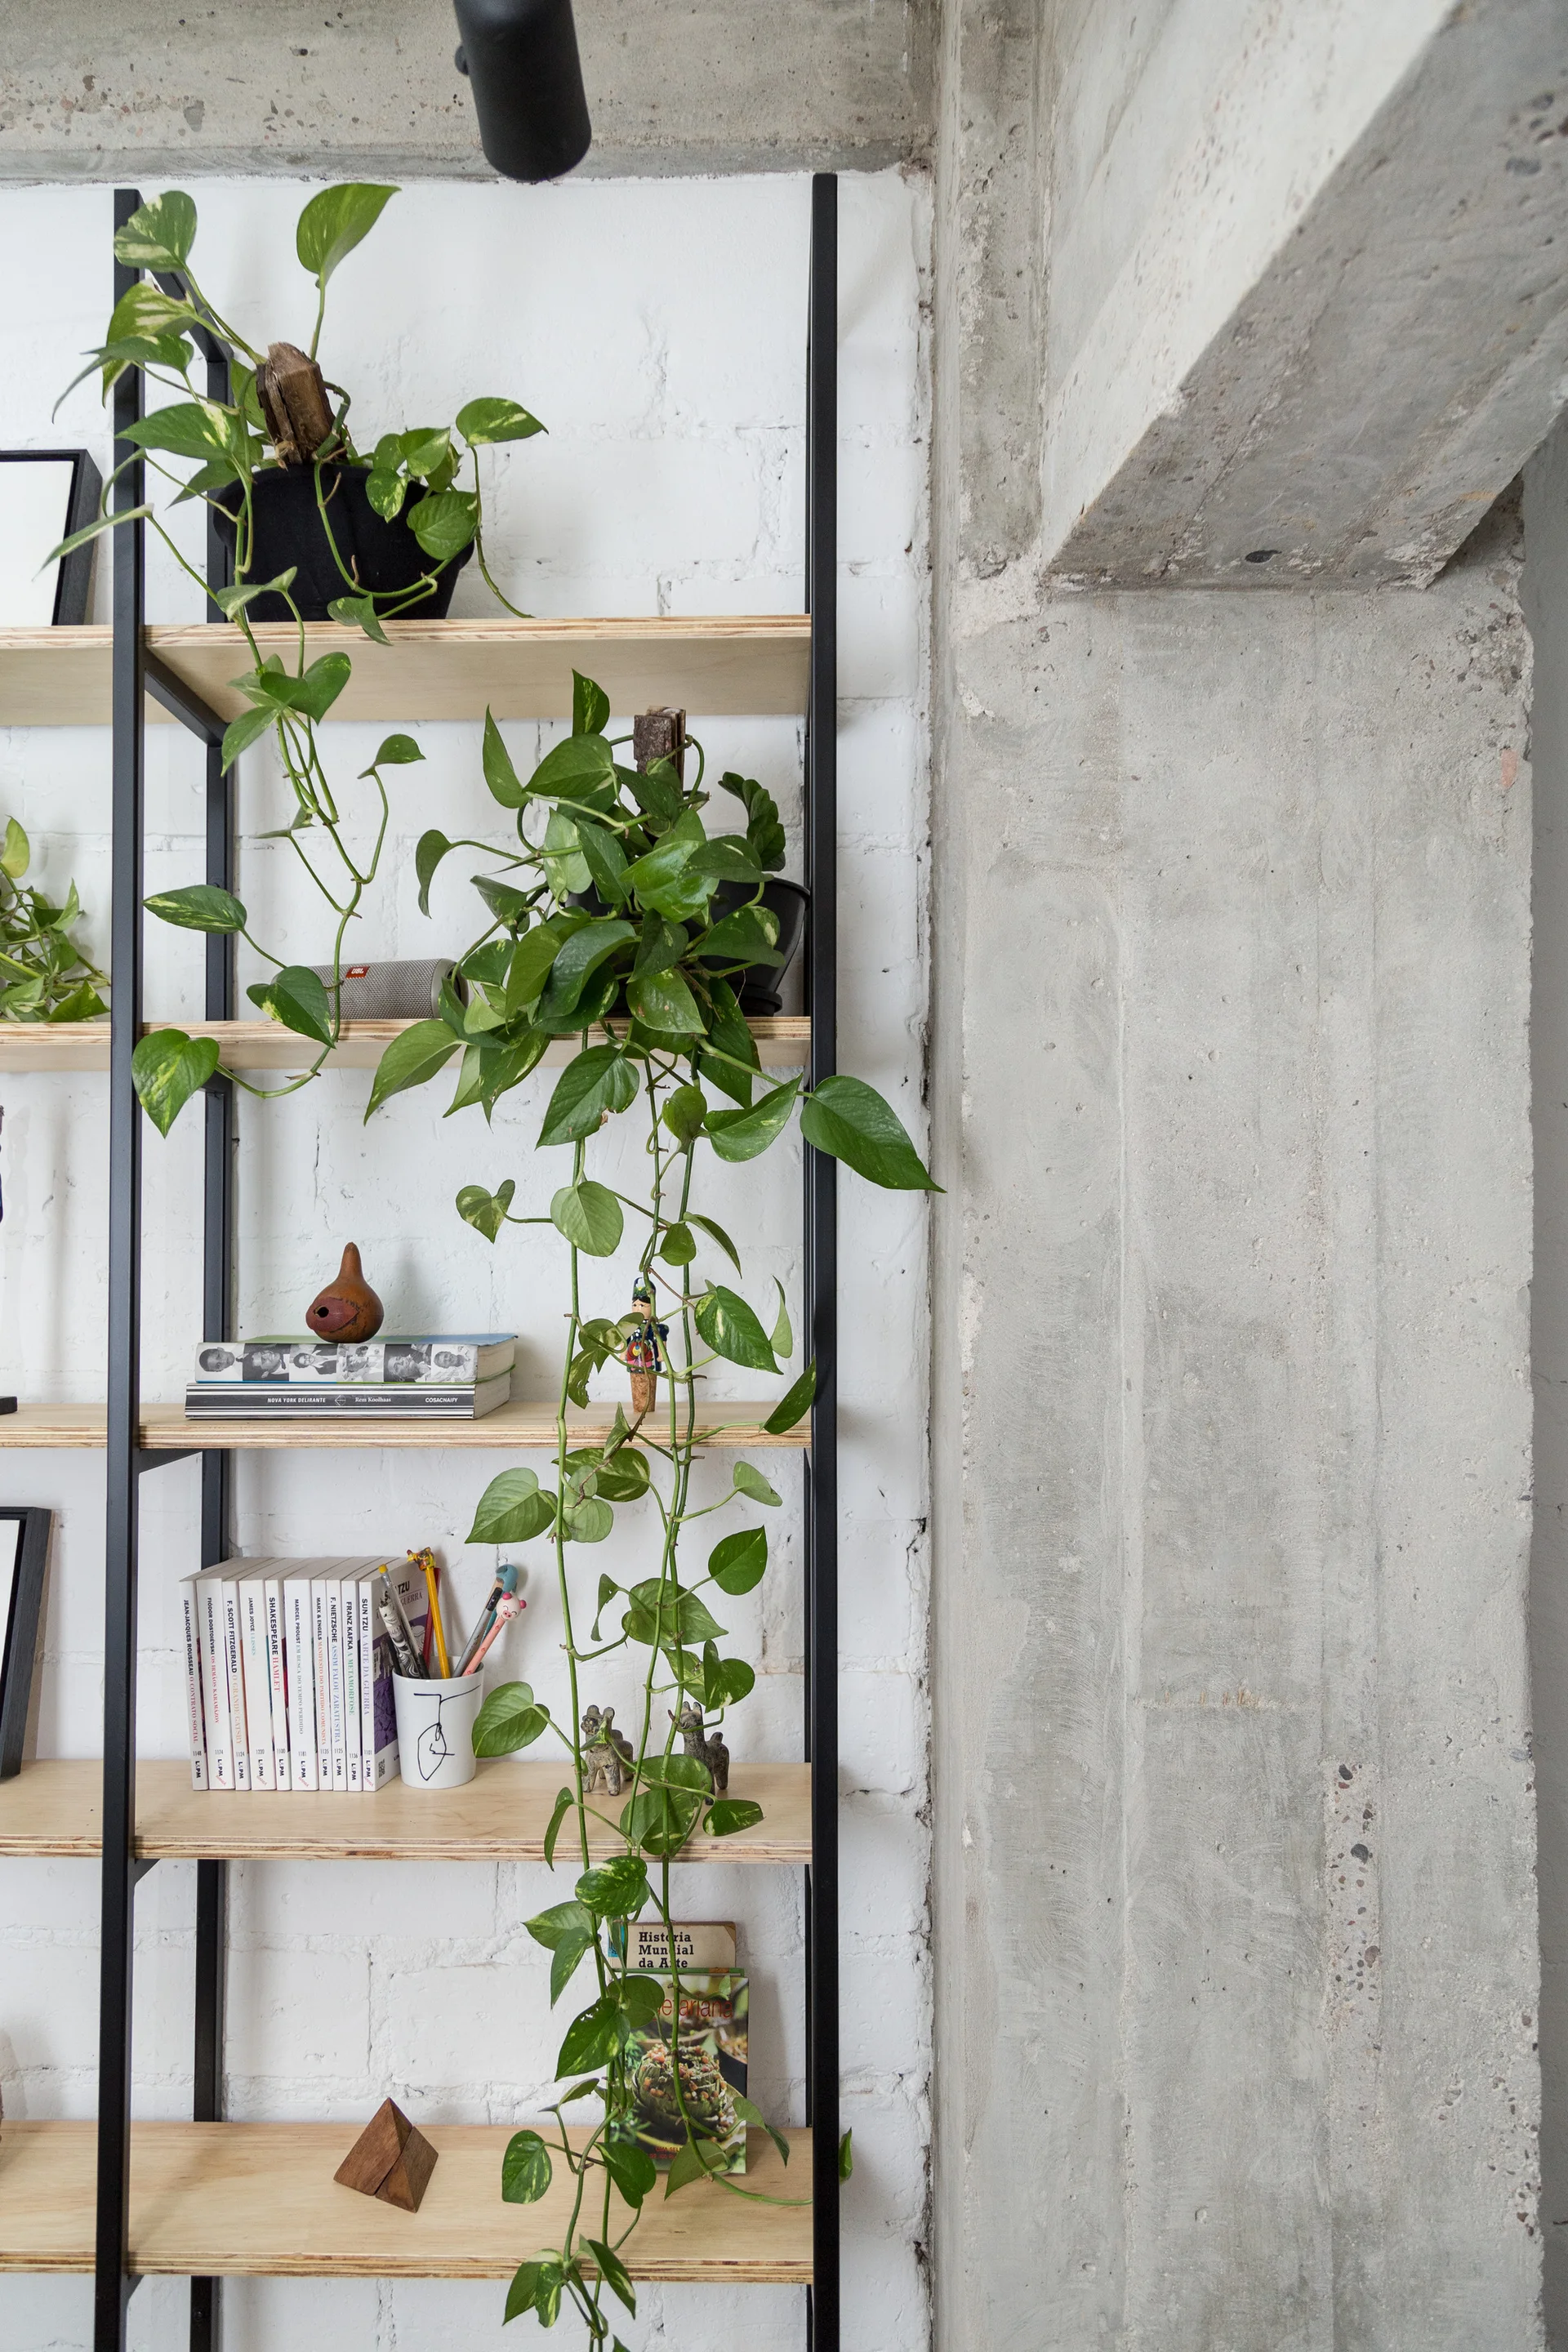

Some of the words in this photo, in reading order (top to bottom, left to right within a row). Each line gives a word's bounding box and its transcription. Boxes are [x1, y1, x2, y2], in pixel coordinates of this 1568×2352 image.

[399, 1580, 410, 1595] TZU
[183, 1599, 191, 1643] JEAN-JACQUES
[269, 1597, 278, 1655] SHAKESPEARE
[229, 1630, 237, 1673] FITZGERALD
[272, 1656, 281, 1691] HAMLET
[319, 1676, 323, 1684] DO
[363, 1666, 369, 1677] DA
[232, 1682, 240, 1715] GRANDE
[234, 1716, 242, 1744] GATSBY
[639, 1944, 694, 1955] Munial
[639, 1958, 654, 1968] da
[659, 1957, 688, 1968] Ate
